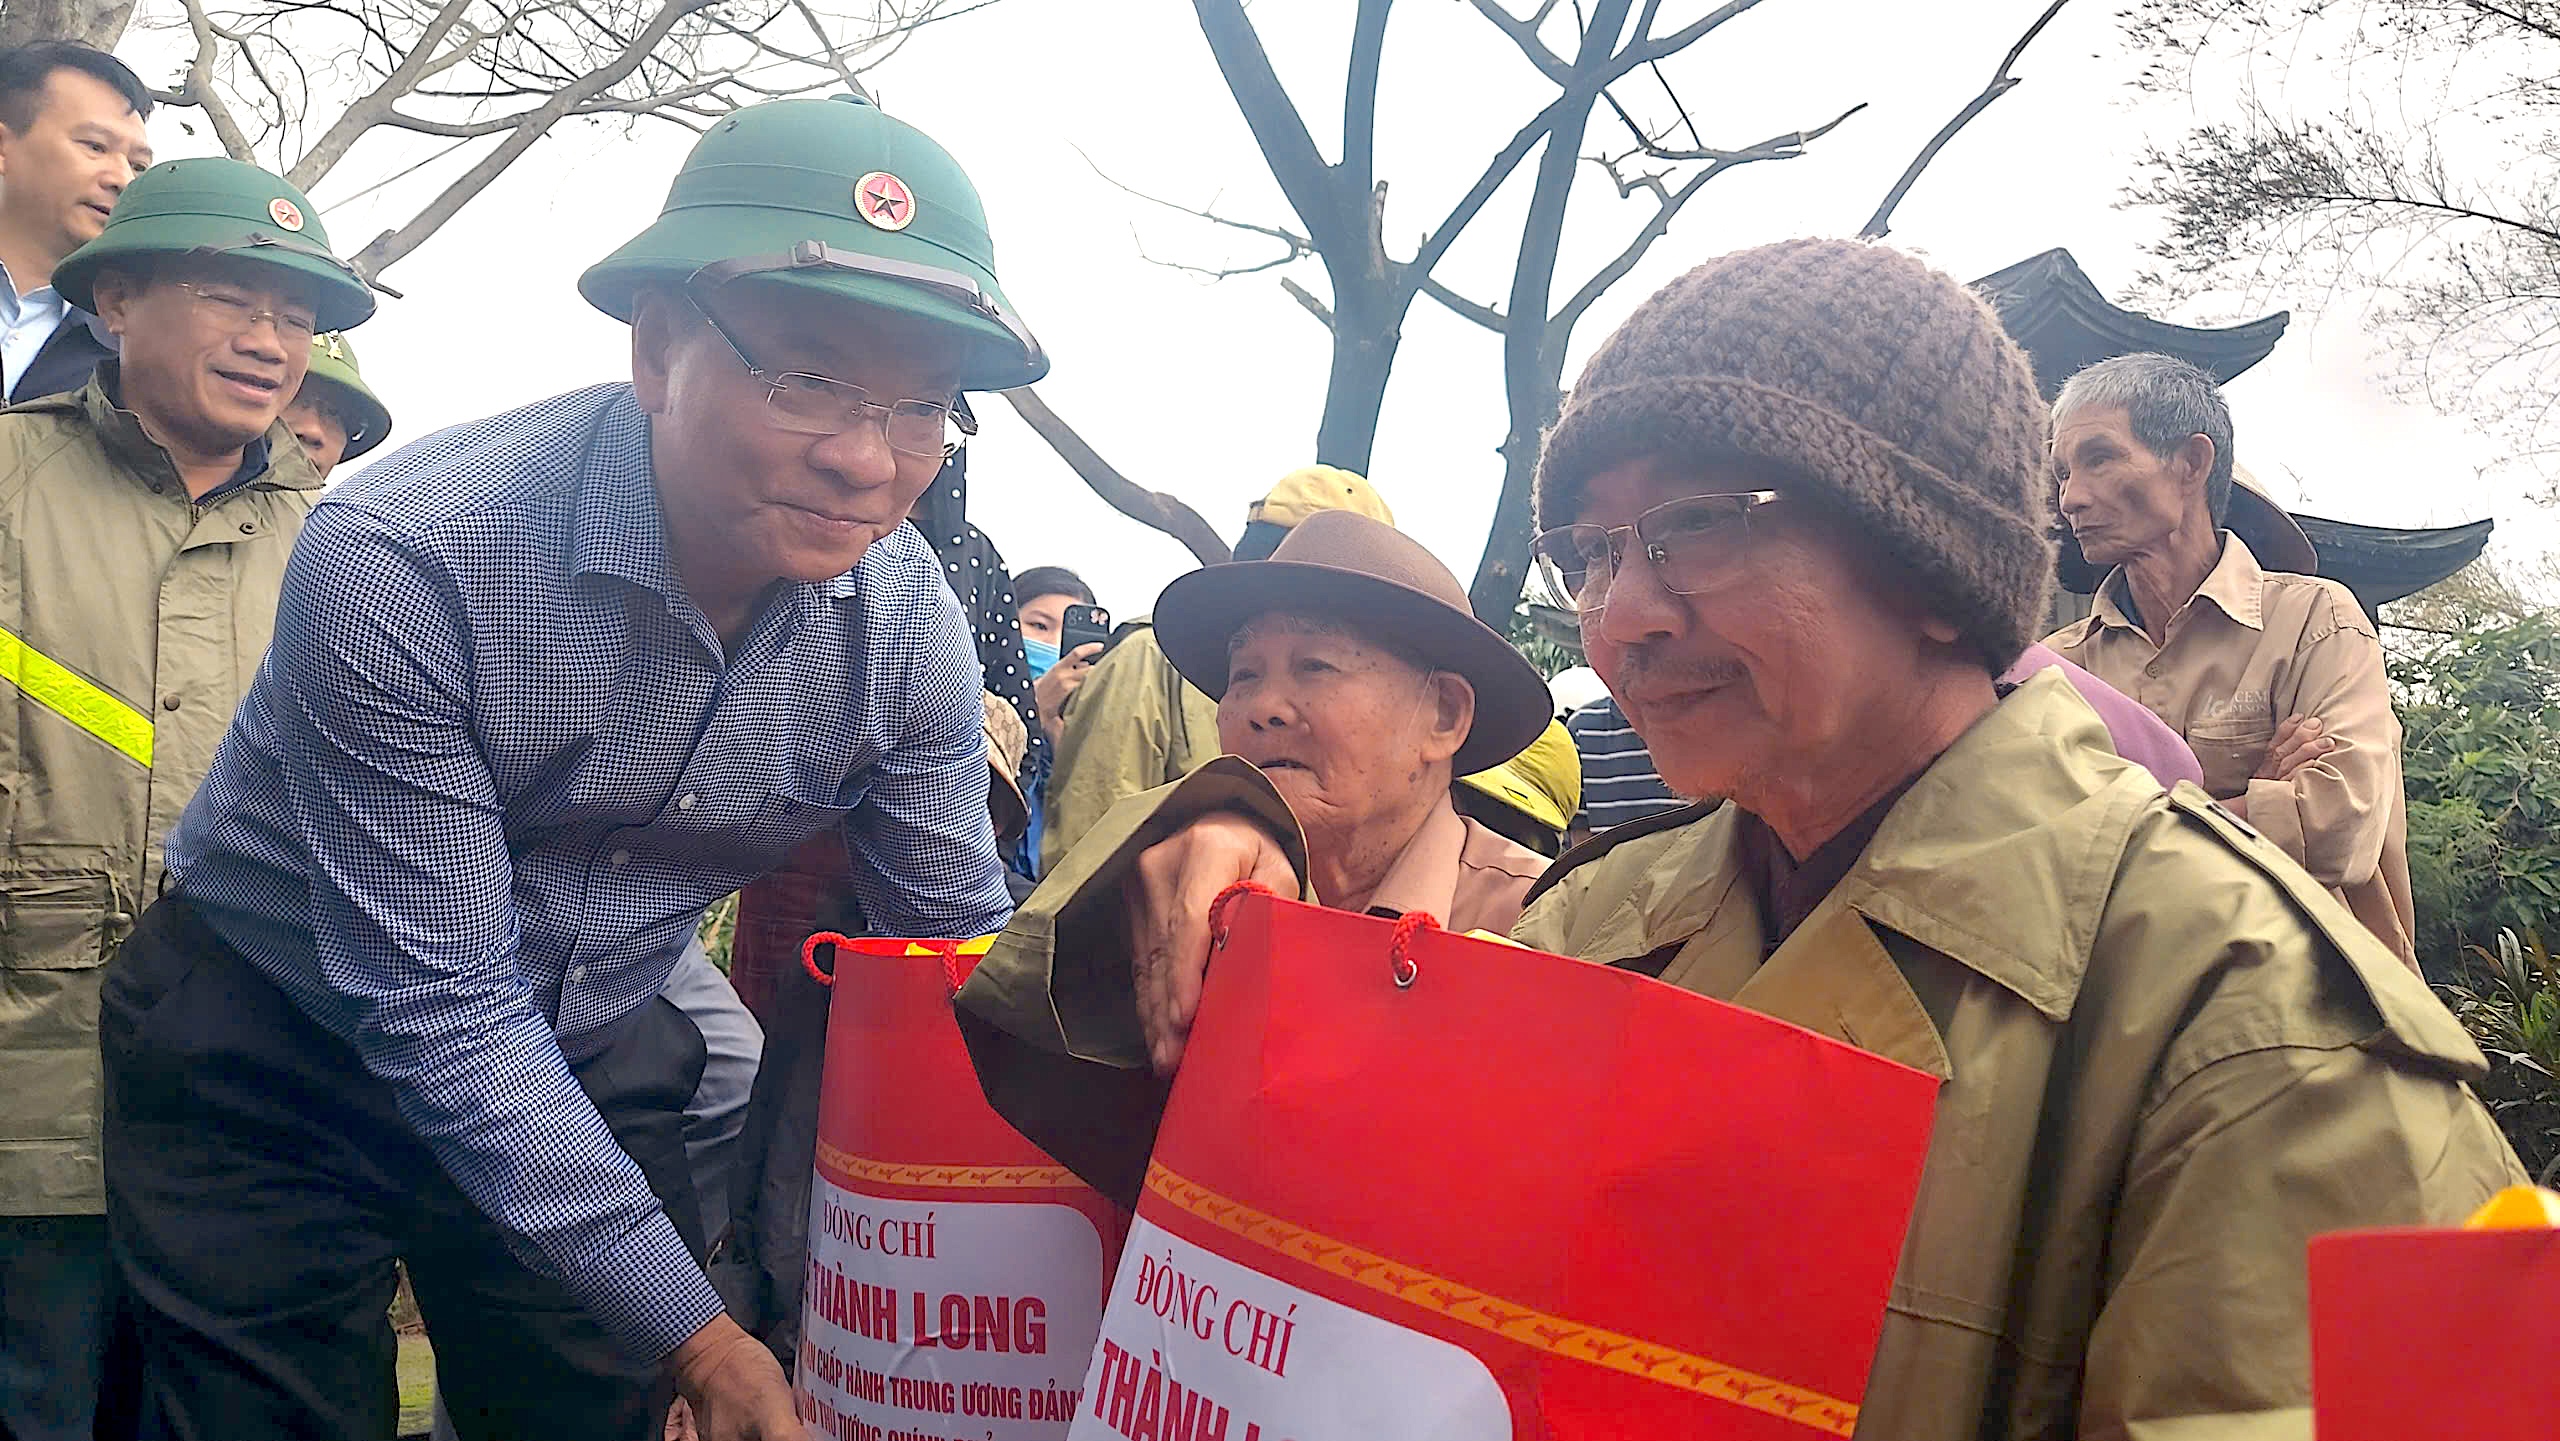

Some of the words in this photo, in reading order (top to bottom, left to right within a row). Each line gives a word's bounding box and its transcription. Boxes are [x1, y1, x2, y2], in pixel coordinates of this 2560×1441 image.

[824, 1193, 871, 1250] ĐỒNG
[879, 1211, 936, 1259] CHÍ
[813, 1258, 897, 1343] THÀNH
[913, 1291, 1047, 1355] LONG
[1134, 1249, 1218, 1340] ĐỒNG
[1223, 1303, 1297, 1378] CHÍ
[818, 1345, 842, 1388] CHẤP
[846, 1360, 885, 1405] HÀNH
[889, 1376, 954, 1415] TRUNG
[962, 1382, 1021, 1420] ƯƠNG
